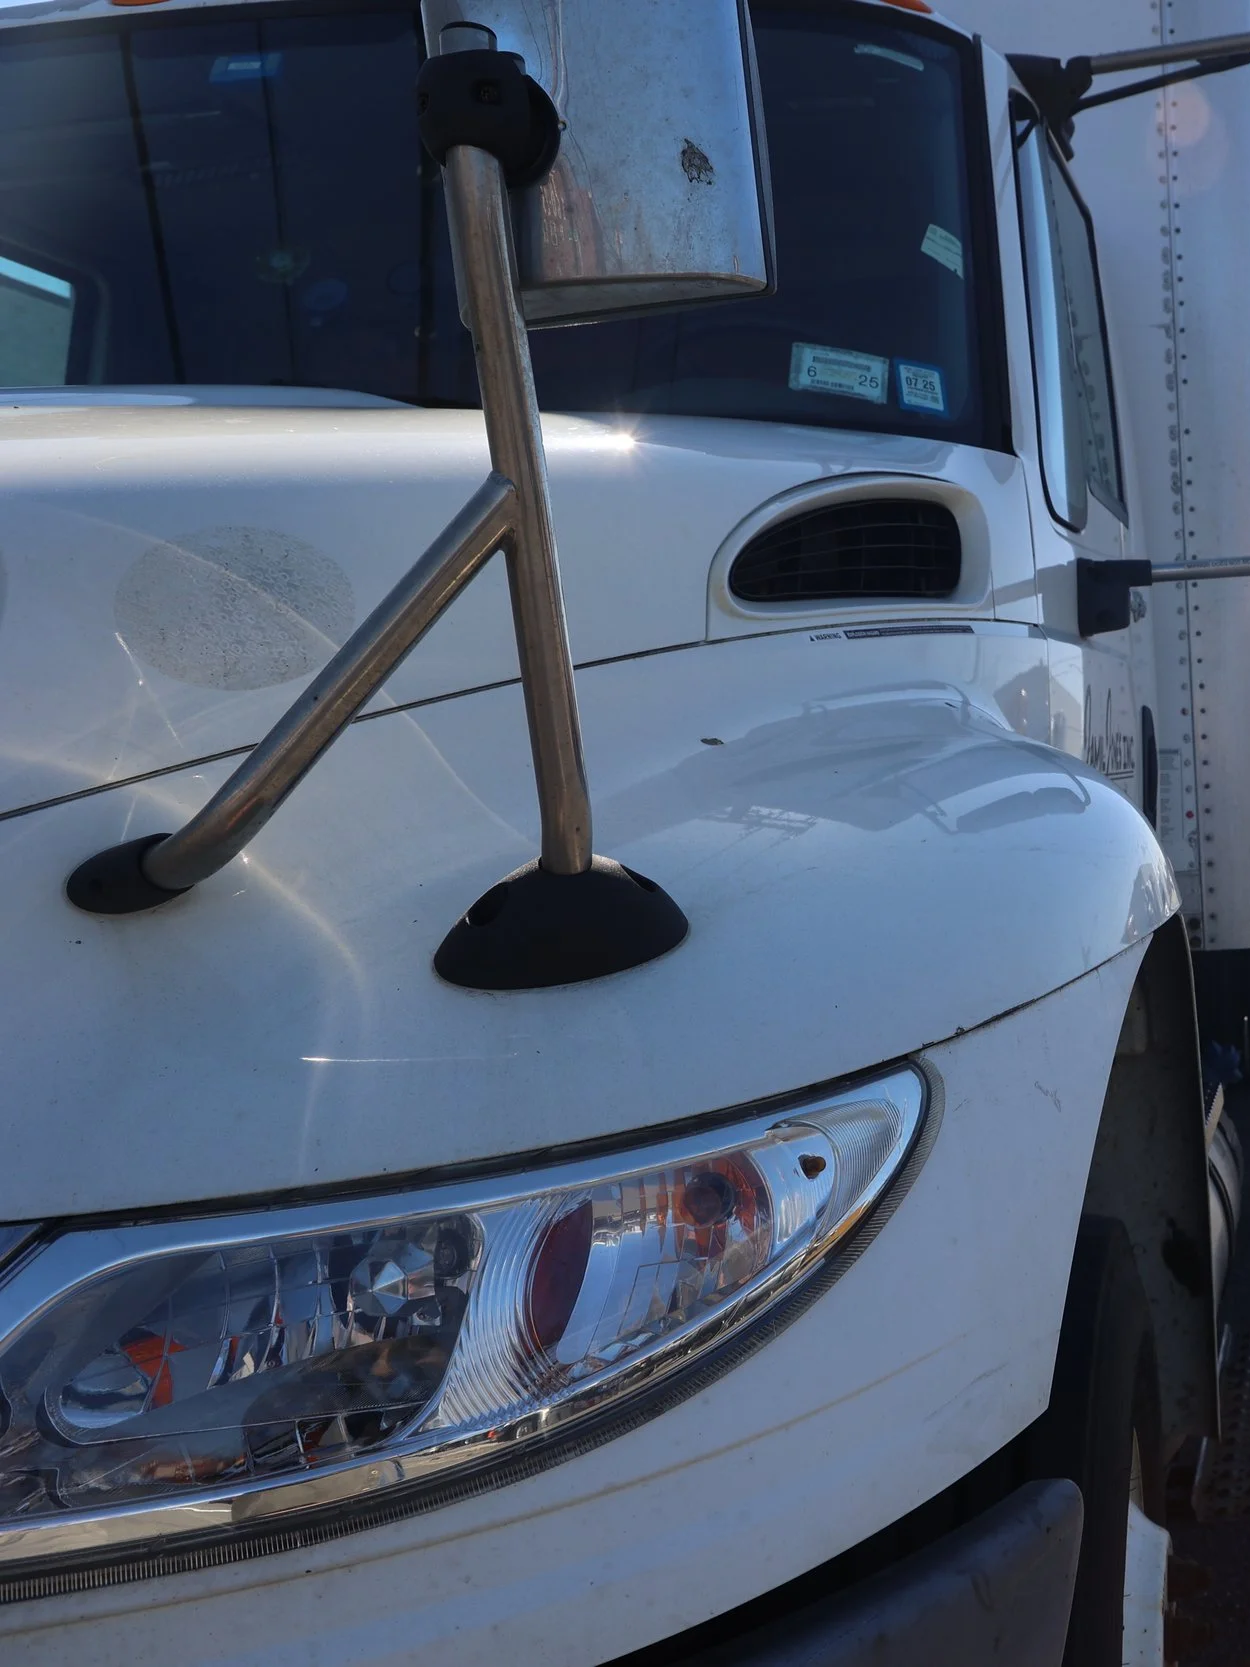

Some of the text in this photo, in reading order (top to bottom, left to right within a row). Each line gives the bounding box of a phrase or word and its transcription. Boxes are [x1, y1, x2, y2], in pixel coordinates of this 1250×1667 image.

[807, 365, 818, 378] 6
[858, 374, 880, 390] 25
[905, 375, 936, 392] 07 25
